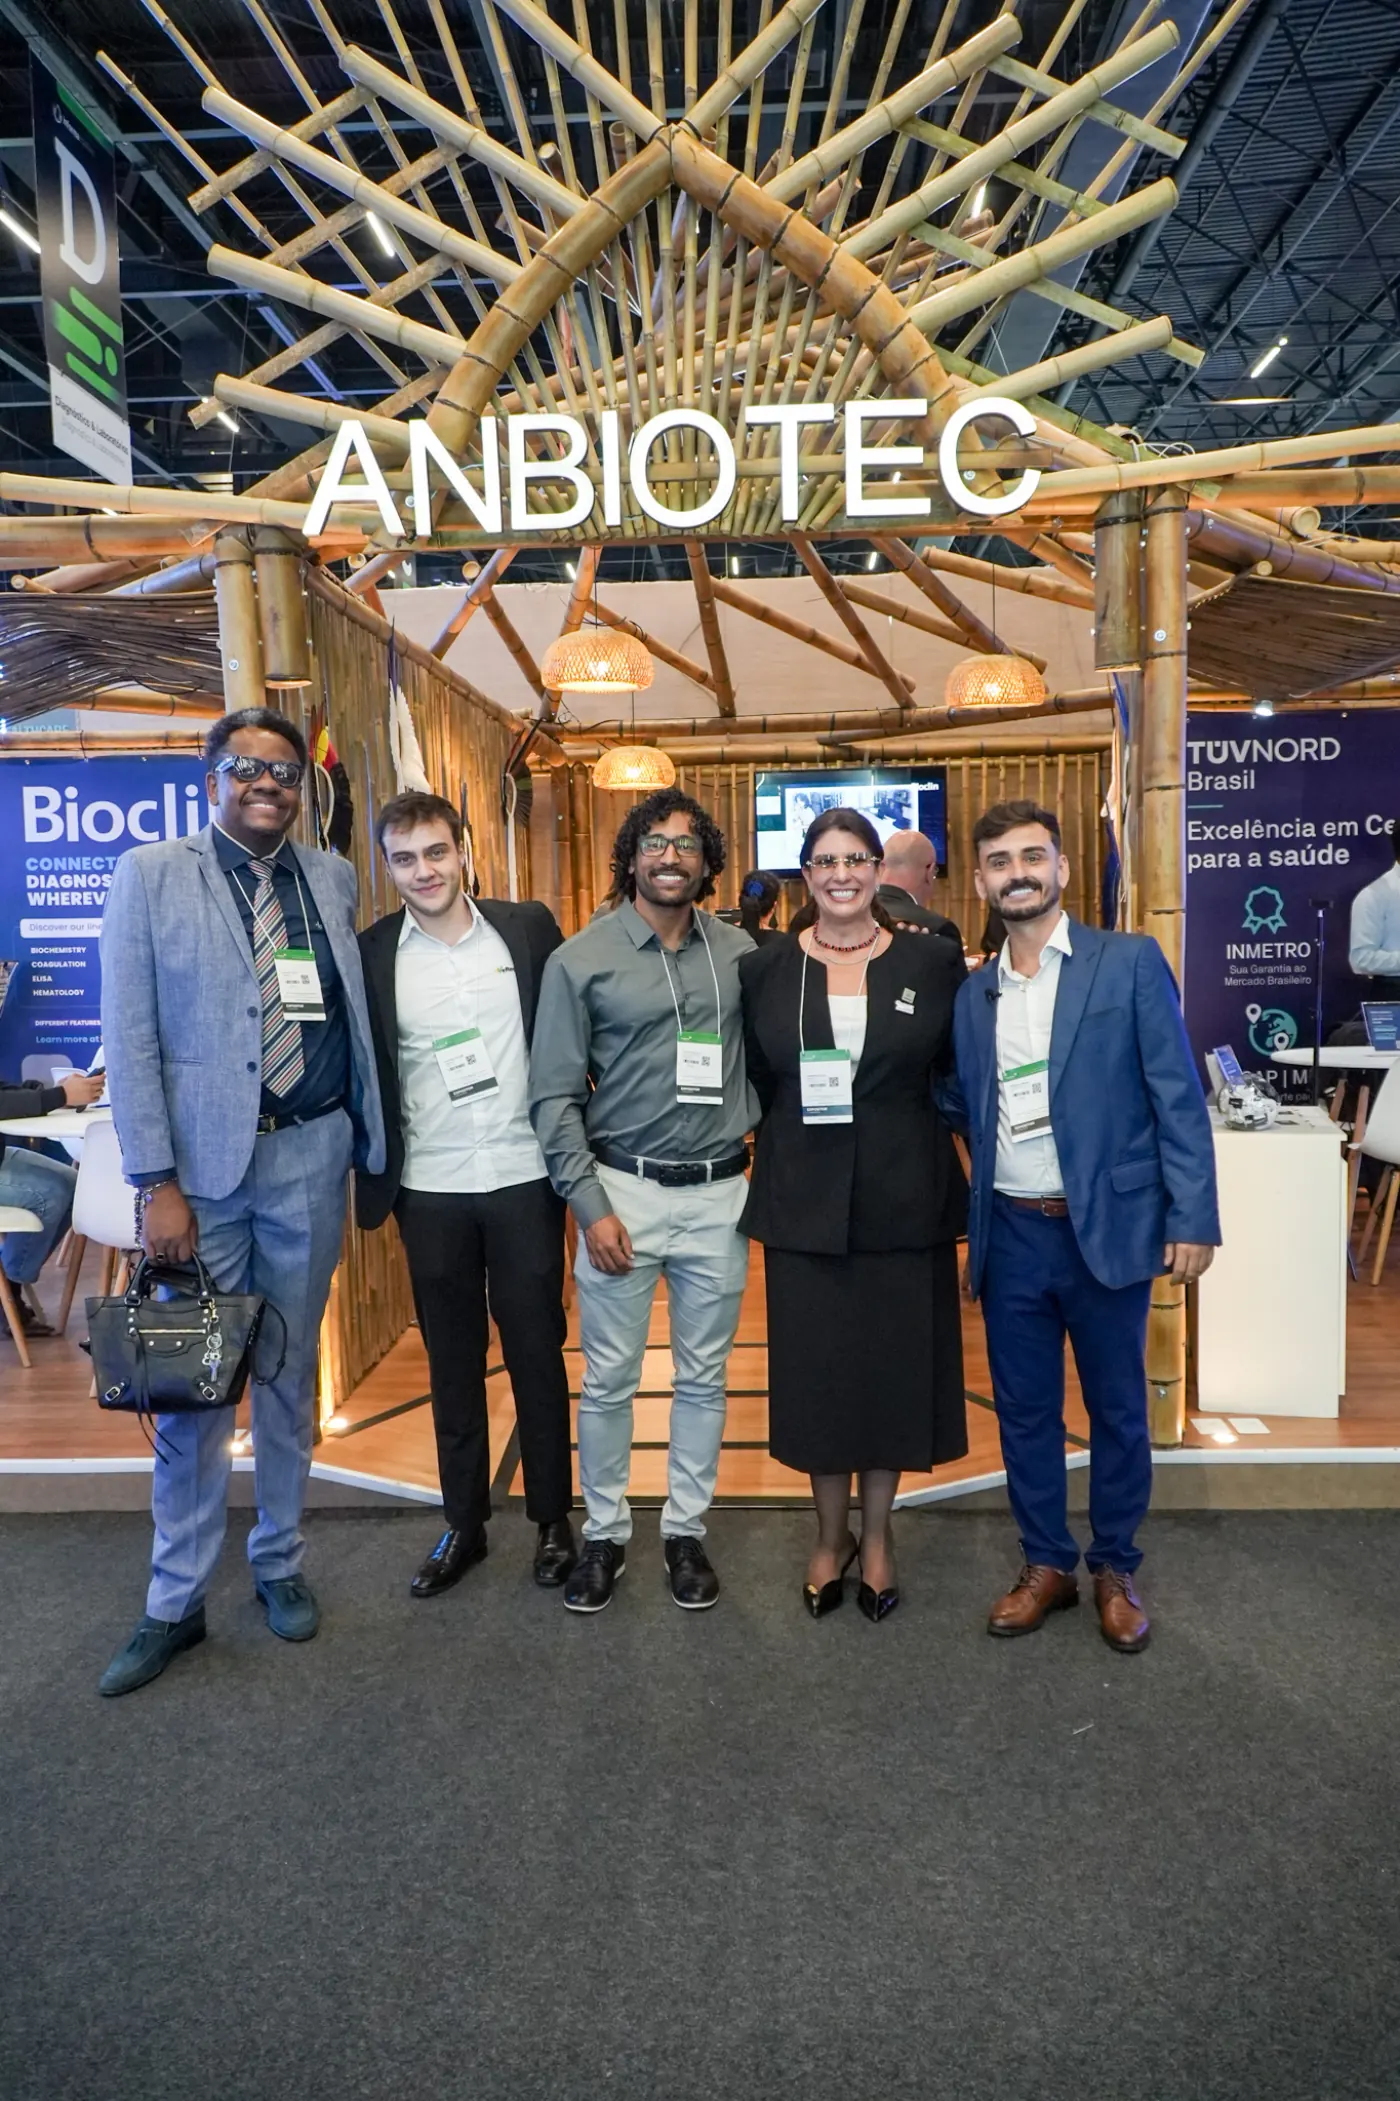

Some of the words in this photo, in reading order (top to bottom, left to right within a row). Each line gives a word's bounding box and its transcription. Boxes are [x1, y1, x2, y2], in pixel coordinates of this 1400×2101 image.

[302, 396, 1041, 537] ANBIOTEC
[1188, 769, 1255, 791] Brasil
[22, 783, 215, 843] Biocli
[1188, 818, 1316, 840] Excelência
[1323, 820, 1358, 837] em
[25, 857, 119, 871] CONNECT
[1188, 852, 1241, 873] para
[1248, 851, 1262, 867] a
[1269, 843, 1350, 867] saúde
[26, 873, 113, 889] DIAGNOS
[27, 891, 106, 906] WHEREV
[30, 923, 68, 931] Discover
[30, 946, 87, 954] BIOCHEMISTRY
[1226, 942, 1311, 959] INMETRO
[1229, 965, 1249, 974] Sua
[1250, 964, 1292, 974] Garantia
[1293, 965, 1307, 973] ao
[1224, 976, 1265, 986] Mercado
[1267, 975, 1312, 985] Brasileiro
[36, 1035, 62, 1043] Learn
